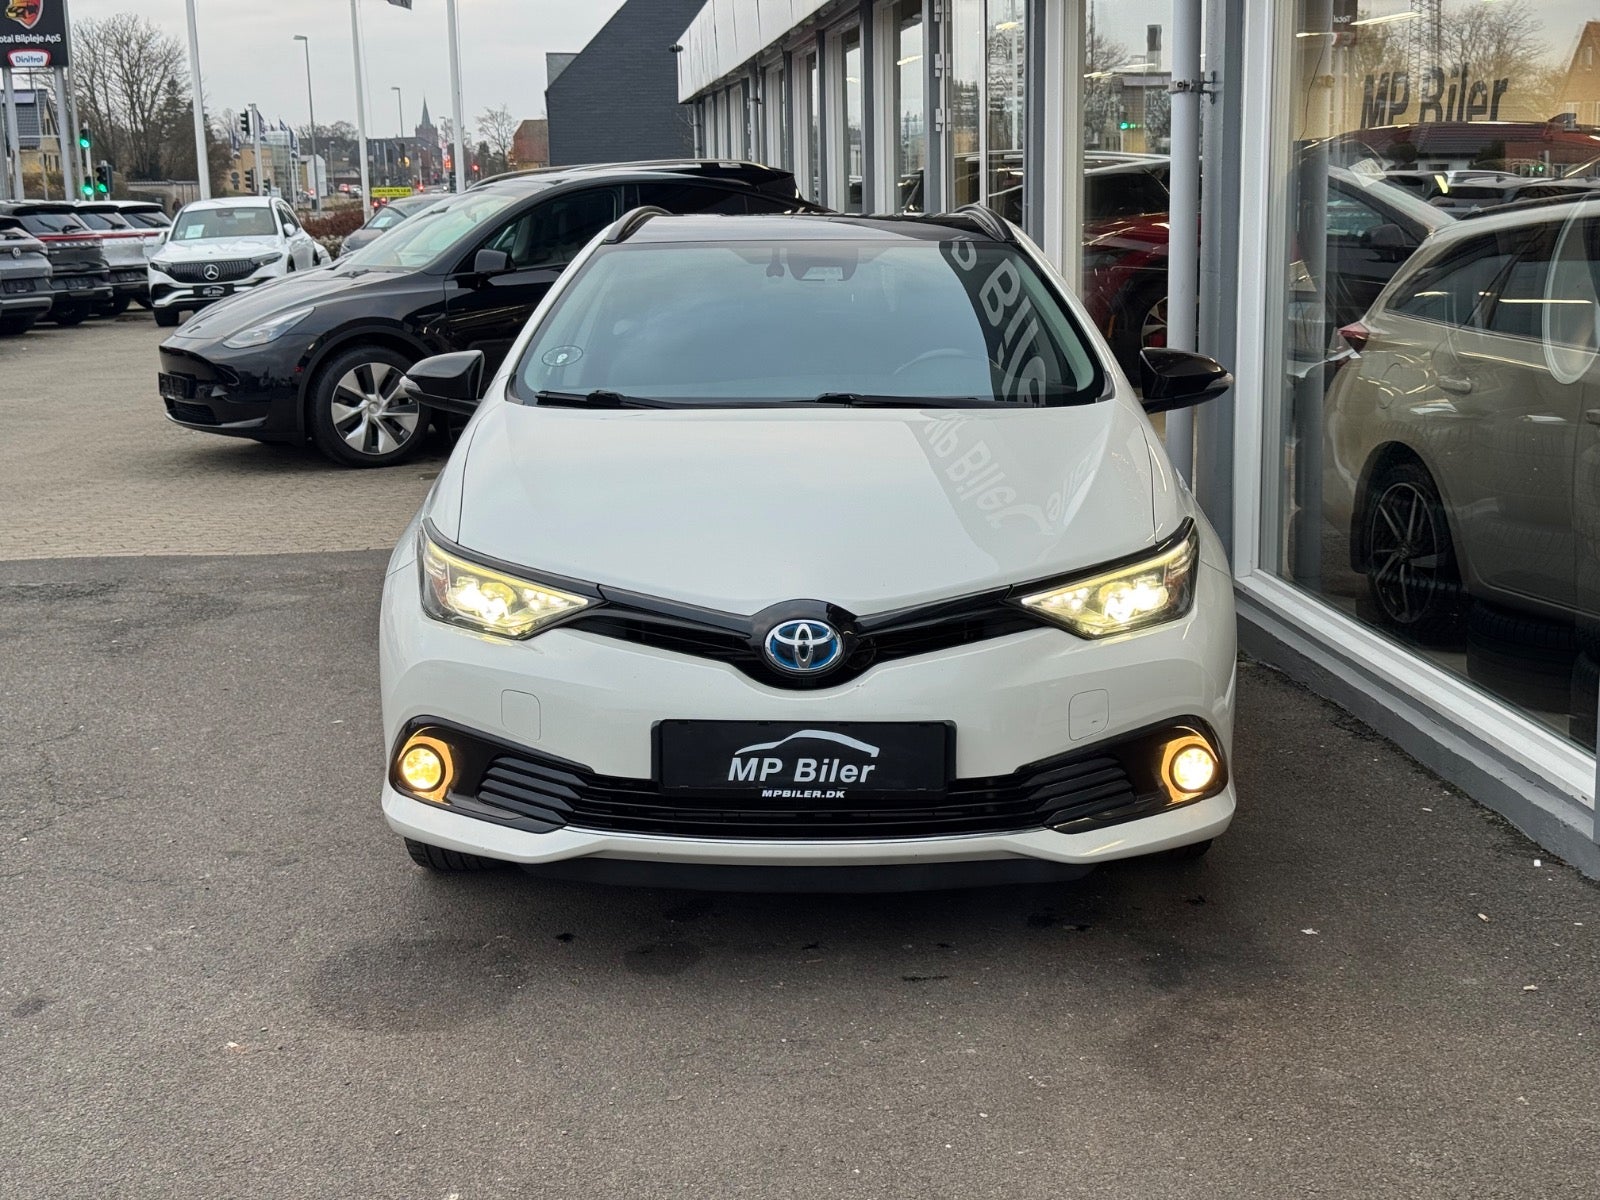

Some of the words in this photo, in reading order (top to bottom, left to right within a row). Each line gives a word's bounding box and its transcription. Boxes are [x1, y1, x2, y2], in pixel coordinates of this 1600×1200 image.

[0, 35, 14, 43] otal
[45, 33, 61, 44] ApS
[15, 55, 44, 63] Dinitrol
[1360, 71, 1409, 129] MP
[727, 757, 783, 782] MP
[793, 758, 876, 783] Biler
[761, 789, 846, 799] MPBILER.DK
